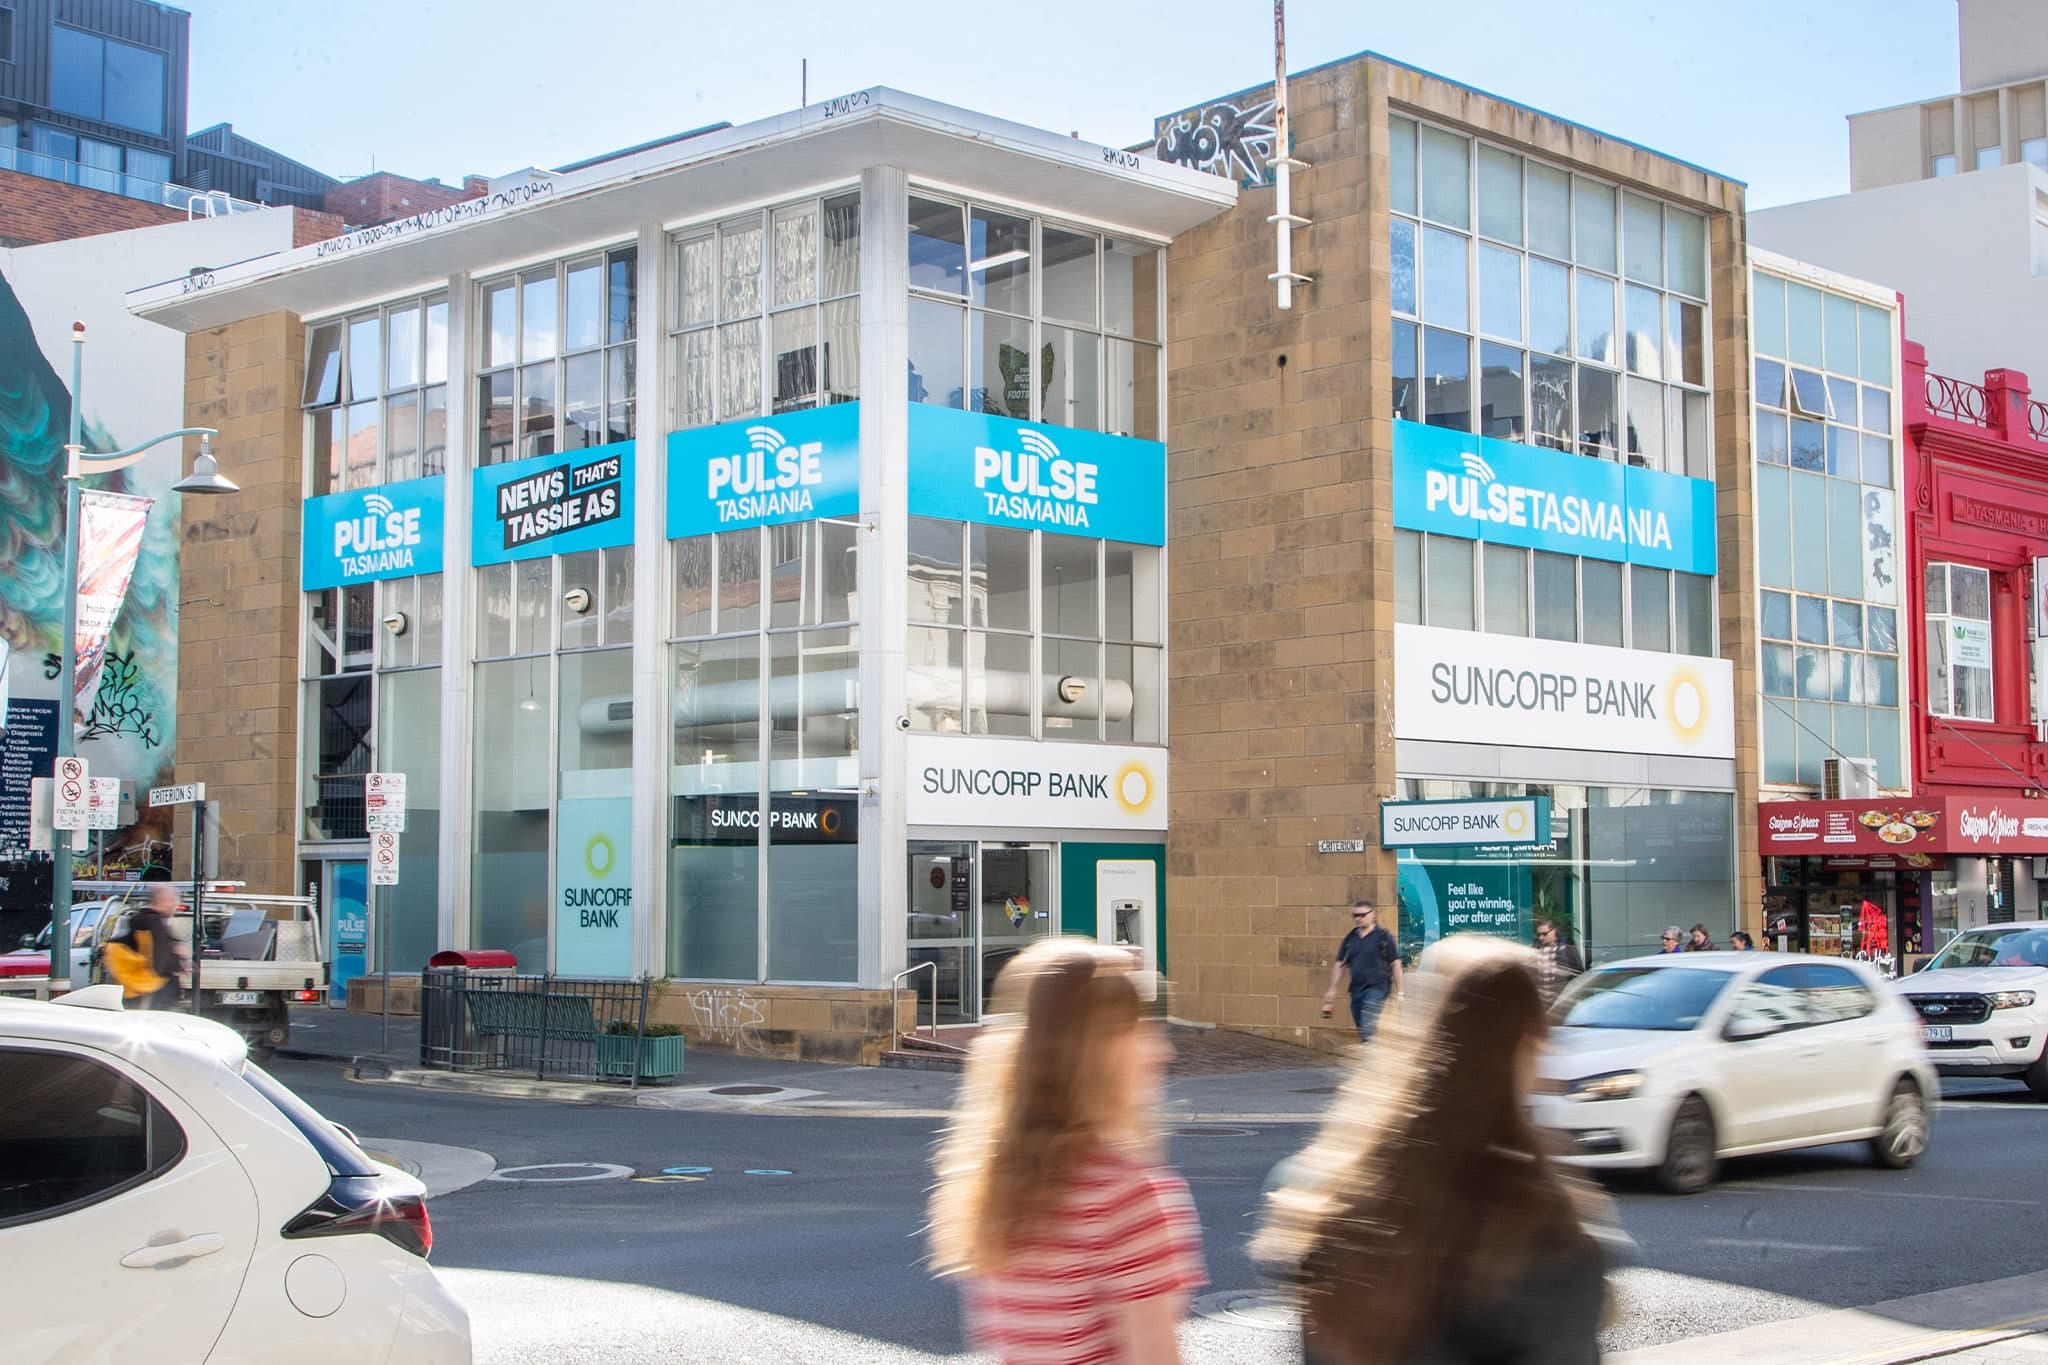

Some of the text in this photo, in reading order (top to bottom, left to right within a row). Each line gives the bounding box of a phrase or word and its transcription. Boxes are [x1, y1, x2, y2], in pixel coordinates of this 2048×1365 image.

[708, 441, 822, 500] PULSE
[975, 446, 1098, 504] PULSE
[501, 459, 619, 514] NEWS THAT'S
[508, 489, 615, 542] TASSIE AS
[716, 489, 813, 523] TASMANIA
[984, 491, 1089, 528] TASMANIA
[1974, 503, 2027, 530] TASMANIA
[335, 508, 421, 557] PULSE
[341, 548, 413, 578] TASMANIA
[1432, 662, 1656, 720] SUNCORP BANK
[152, 788, 185, 804] CRITERION
[923, 767, 1108, 799] SUNCORP BANK
[711, 810, 817, 829] SUNCOP BANK
[1394, 814, 1499, 832] SUNCORP BANK
[1769, 814, 1793, 832] Saigon
[1960, 806, 1989, 844] Saigon
[1322, 840, 1356, 851] CRITERION
[1448, 883, 1484, 896] Feel like
[581, 909, 618, 928] BANK
[1448, 897, 1515, 912] you're winning,
[1448, 911, 1517, 926] year after year.
[337, 919, 365, 932] PULSE
